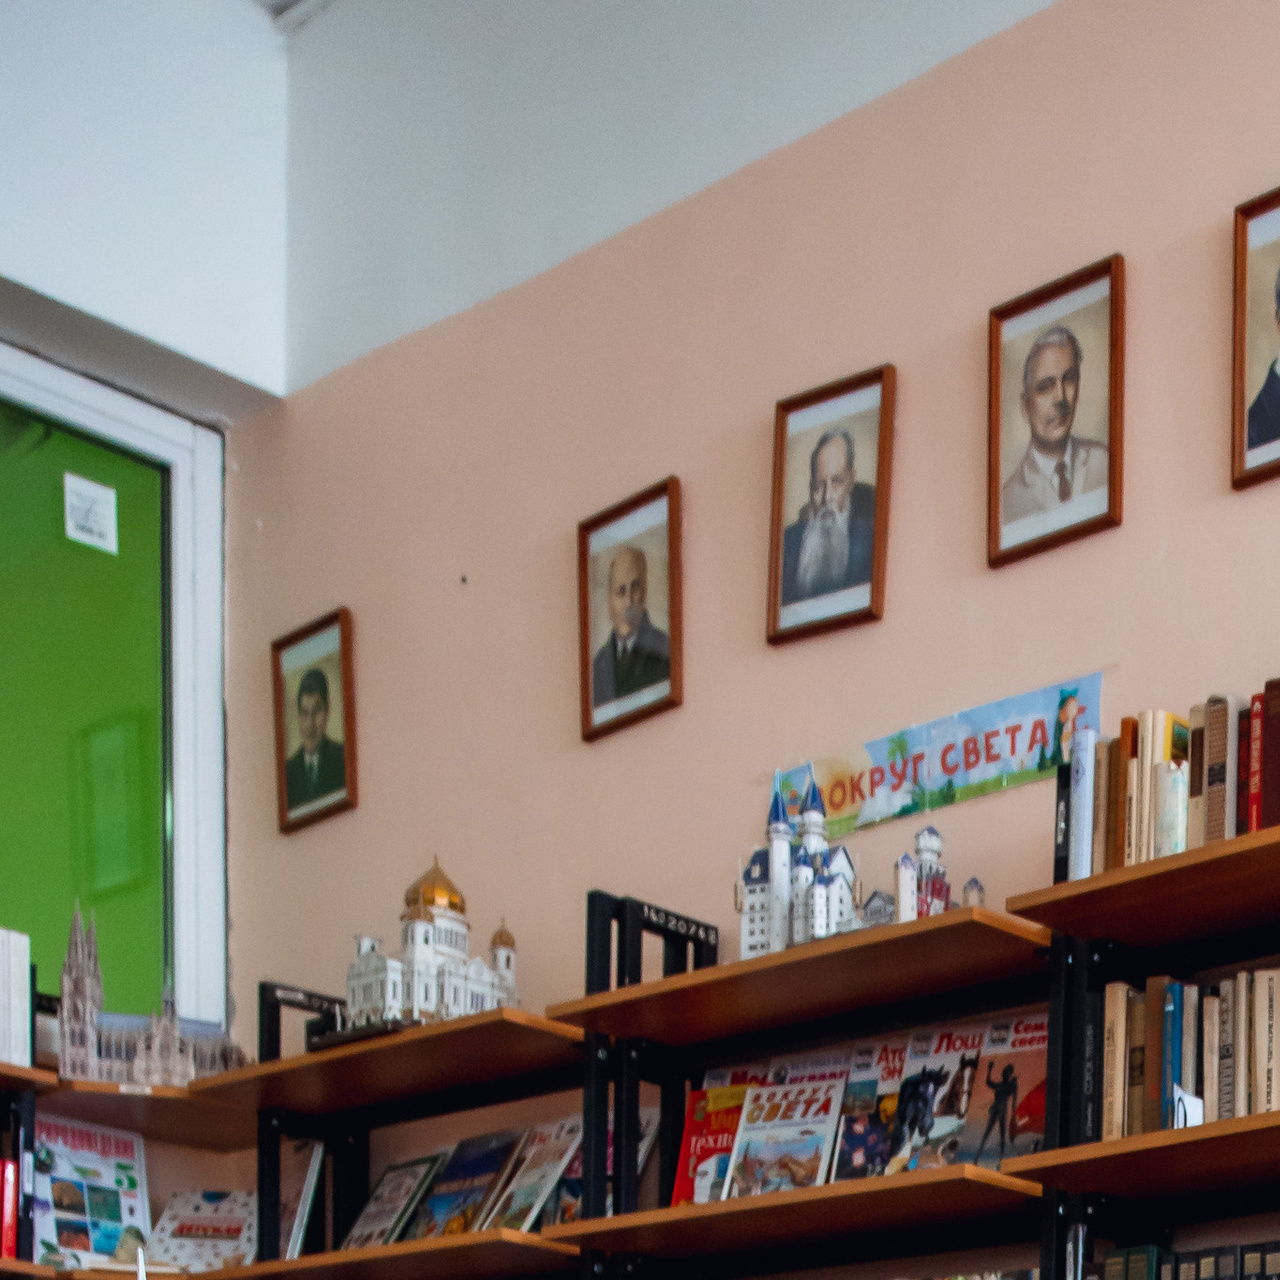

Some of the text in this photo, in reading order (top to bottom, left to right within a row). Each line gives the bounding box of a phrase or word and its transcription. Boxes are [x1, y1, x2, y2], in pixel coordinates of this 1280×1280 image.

[941, 719, 1049, 774] СВЕТА
[751, 1085, 836, 1104] ВОКРУГ
[747, 1098, 831, 1123] СВЕТА
